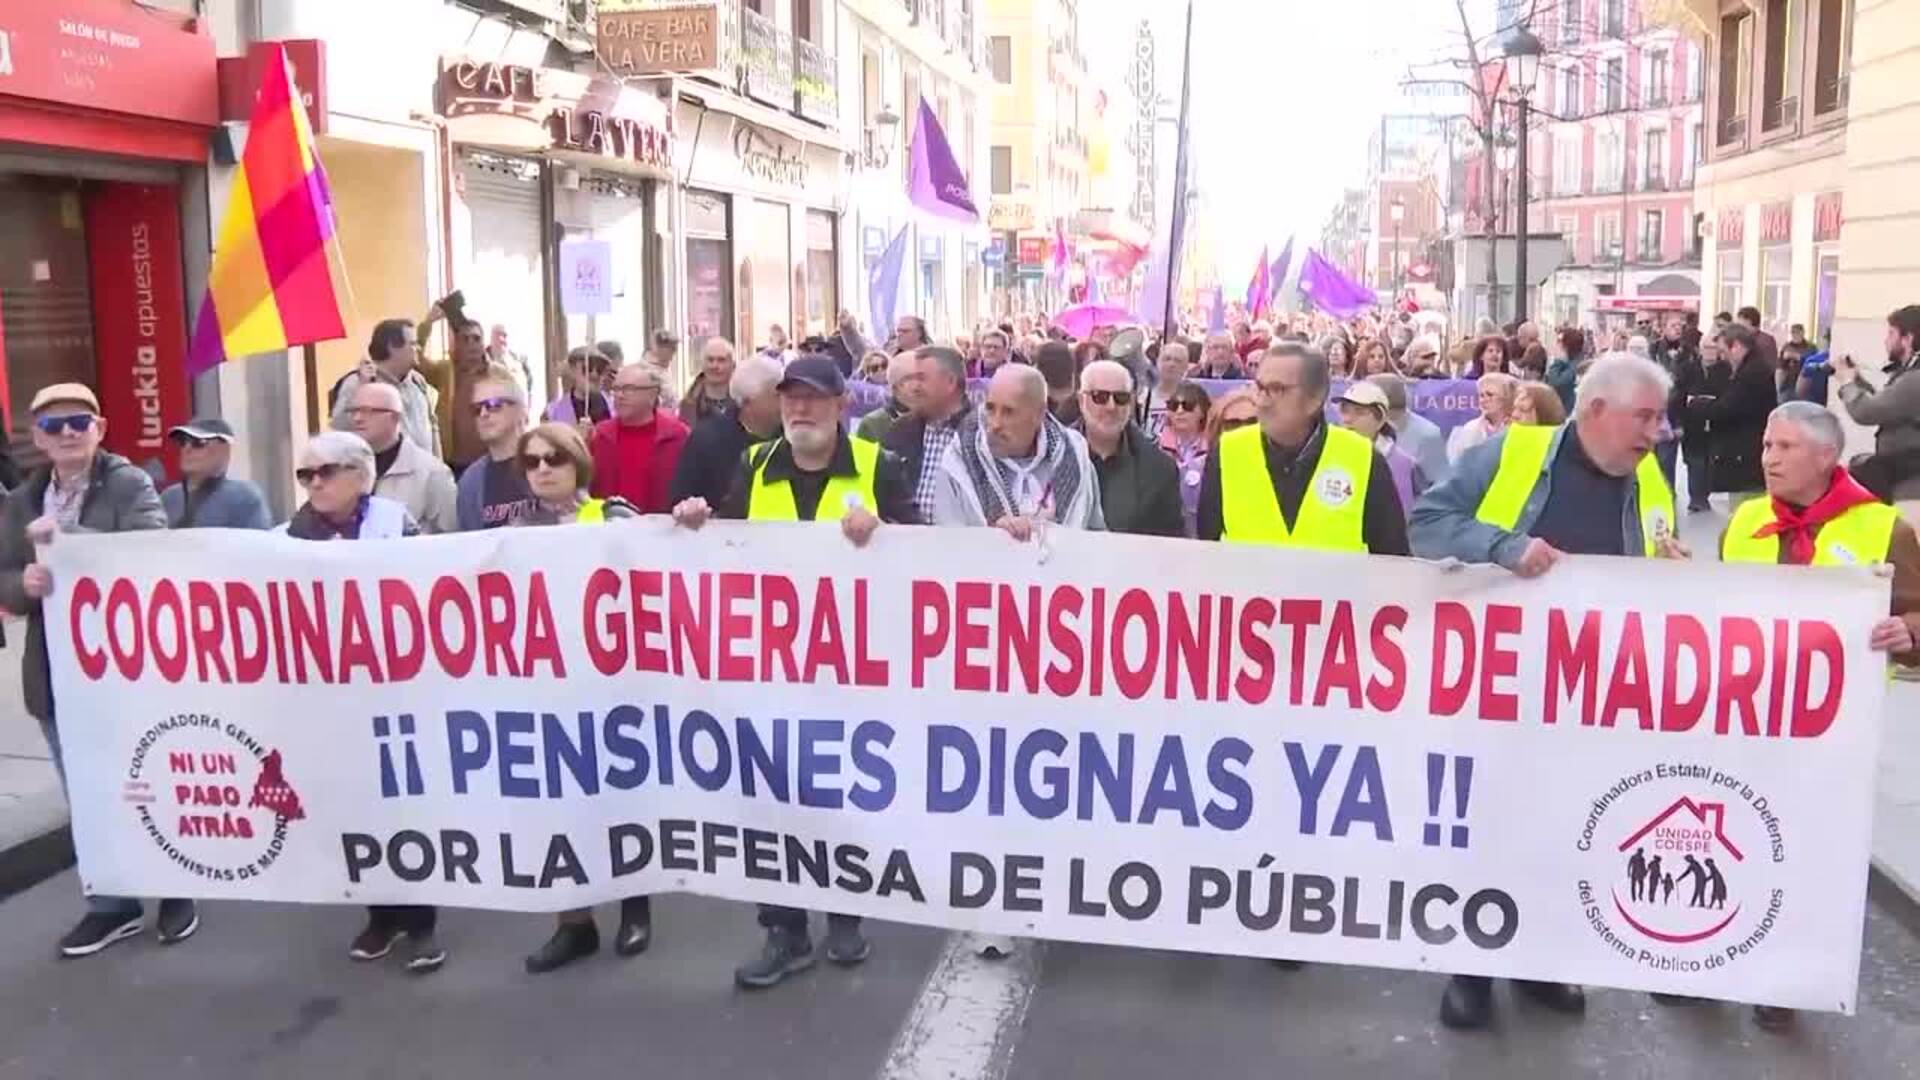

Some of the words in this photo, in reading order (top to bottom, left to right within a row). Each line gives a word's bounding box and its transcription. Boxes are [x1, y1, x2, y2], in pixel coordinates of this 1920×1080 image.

[602, 19, 656, 41] CAFE
[666, 14, 709, 36] BAR
[608, 43, 635, 71] LA
[641, 41, 704, 63] VERA
[557, 107, 616, 157] LA
[131, 223, 160, 337] apuestas
[131, 345, 163, 448] luckia
[1414, 395, 1438, 410] LA
[71, 572, 566, 684] COORDINADORA
[584, 568, 889, 686] GENERAL
[912, 581, 1408, 712] PENSIONISTAS
[1429, 602, 1523, 721] DE
[1543, 609, 1845, 738] MADRID
[129, 714, 220, 779] COORDINADORA
[225, 723, 268, 763] GENE
[170, 752, 195, 774] NI
[202, 753, 236, 775] UN
[175, 785, 241, 807] PASO
[446, 705, 897, 811] PENSIONES
[926, 725, 1254, 831] DIGNAS
[1283, 742, 1394, 841] YA
[1423, 753, 1474, 848] !!
[179, 812, 254, 838] ATRÁS
[1577, 769, 1653, 852] Coordinadora
[1655, 763, 1711, 778] Estatal
[1712, 771, 1742, 790] por
[1739, 784, 1755, 801] la
[1752, 797, 1785, 863] Defensa
[136, 805, 235, 881] PENSIONISTAS
[237, 864, 260, 881] DE
[1654, 839, 1712, 853] COESPE
[1655, 827, 1713, 841] UNIDAD
[342, 829, 480, 884] POR
[500, 832, 589, 888] LA
[609, 820, 926, 902] DEFENSA
[949, 851, 1043, 912] DE
[1068, 858, 1162, 921] LO
[1187, 854, 1519, 949] PÚBLICO
[1578, 880, 1596, 906] del
[1586, 906, 1636, 959] Sistema
[1726, 888, 1783, 962] Pensiones
[1638, 950, 1701, 972] Público
[1704, 954, 1726, 970] de
